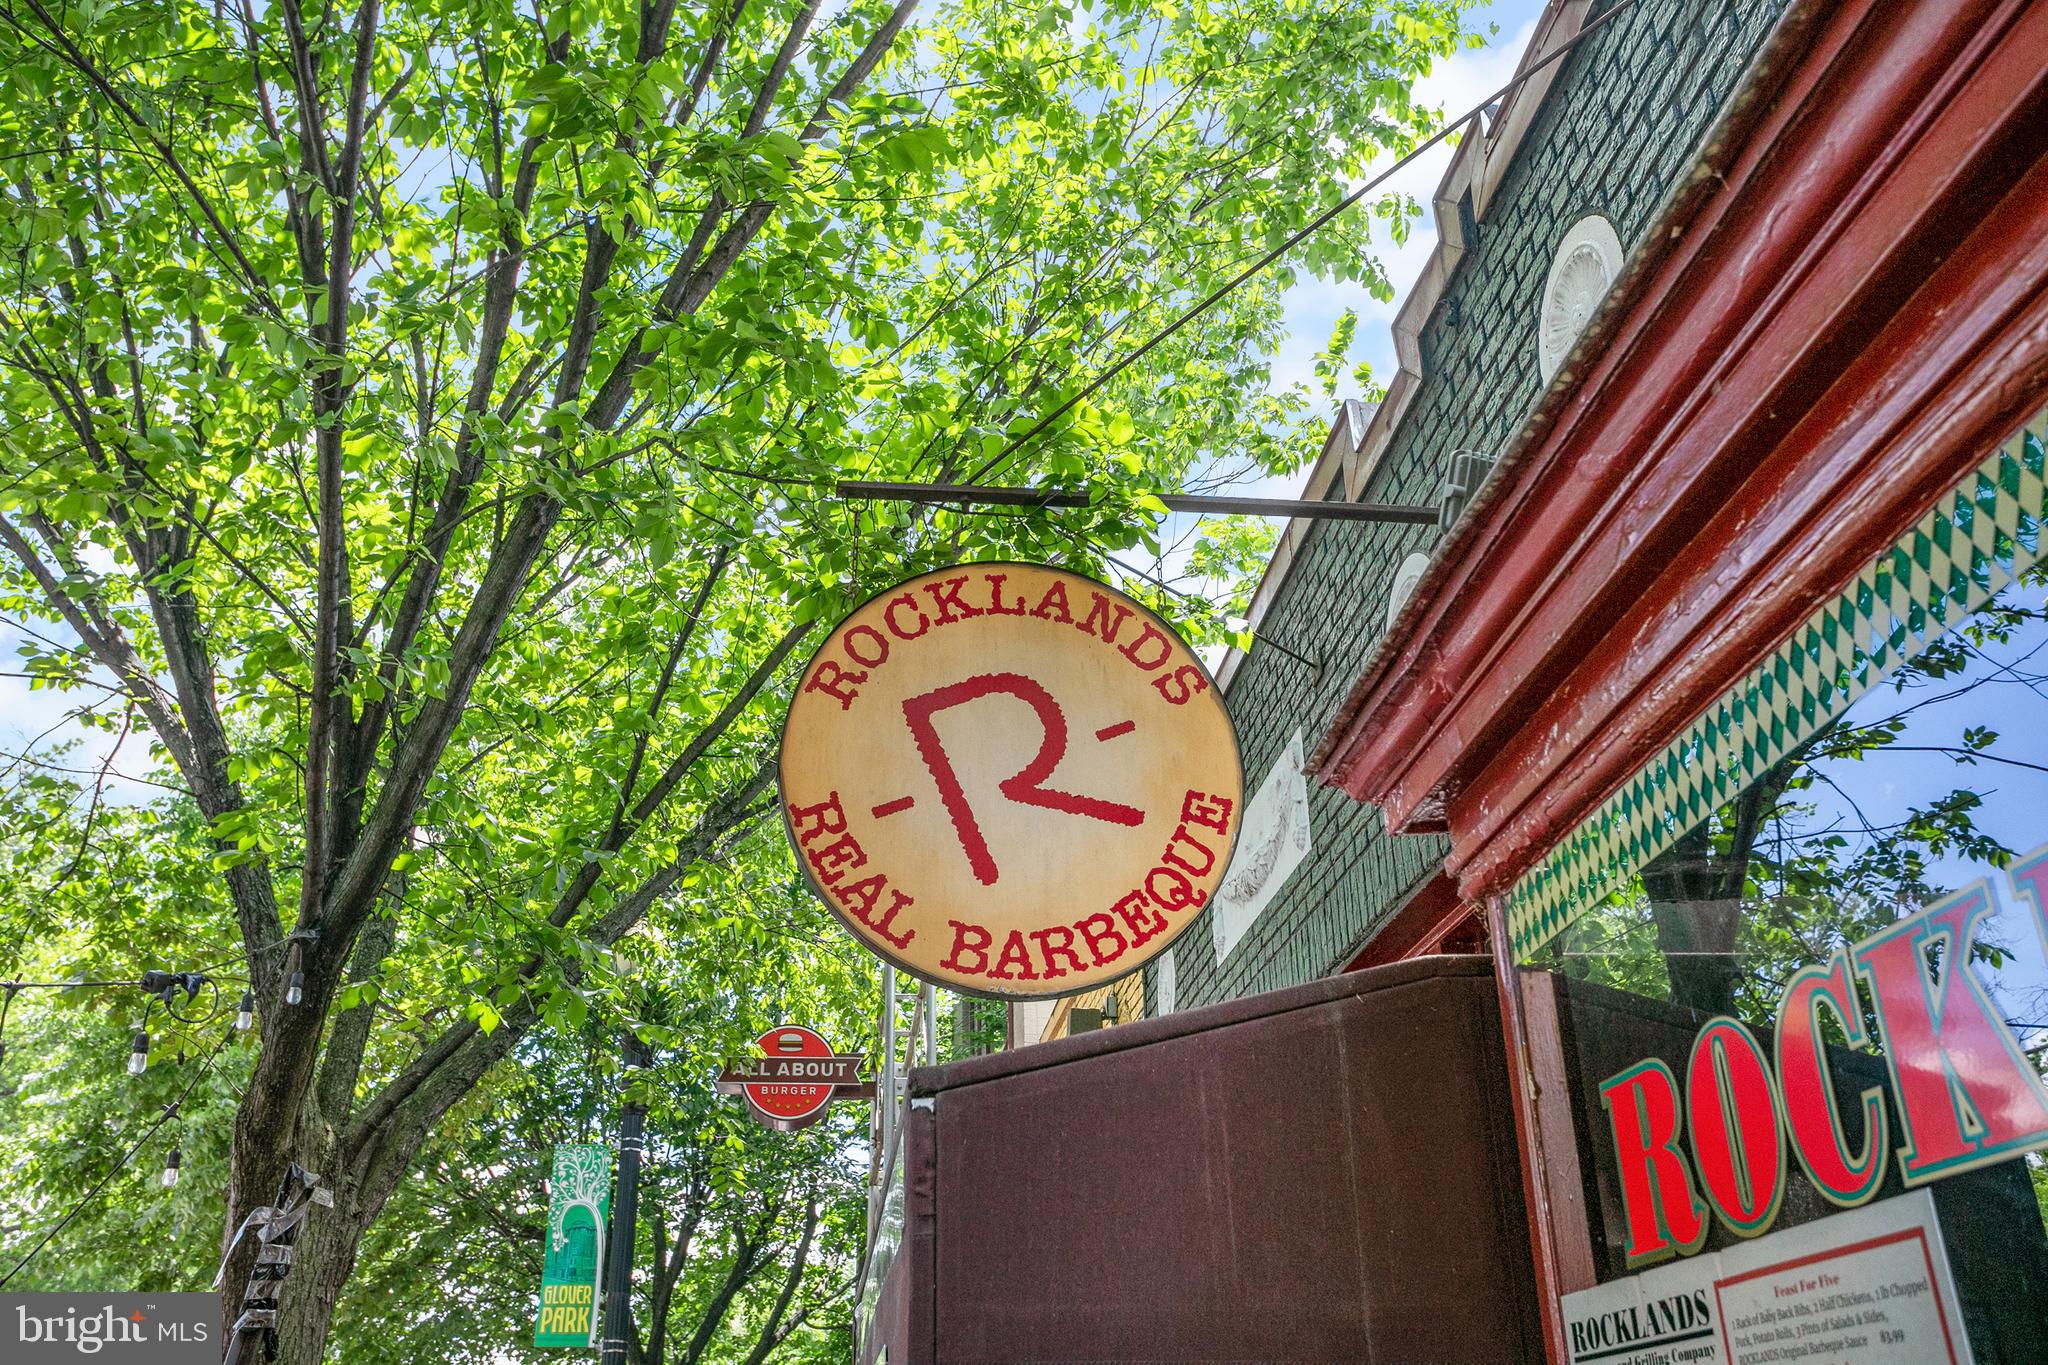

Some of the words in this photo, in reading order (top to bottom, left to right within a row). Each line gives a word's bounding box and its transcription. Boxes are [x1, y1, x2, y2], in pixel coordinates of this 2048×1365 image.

[805, 574, 1207, 710] ROCKLANDS
[789, 791, 916, 950] REAL
[939, 789, 1233, 980] BARBEQUE
[1600, 845, 2048, 1268] ROCK
[776, 1062, 847, 1077] ABOUT
[761, 1086, 817, 1095] BURGER
[544, 1285, 592, 1304] GLOVER
[1774, 1282, 1798, 1298] Feast
[1799, 1279, 1816, 1292] For
[1818, 1274, 1840, 1288] Five
[1890, 1276, 1928, 1298] Chopped
[539, 1306, 590, 1333] PARK
[1570, 1289, 1711, 1353] ROCKLANDS
[1671, 1344, 1716, 1364] Company
[1780, 1342, 1809, 1361] Original
[1844, 1335, 1868, 1350] Sauce
